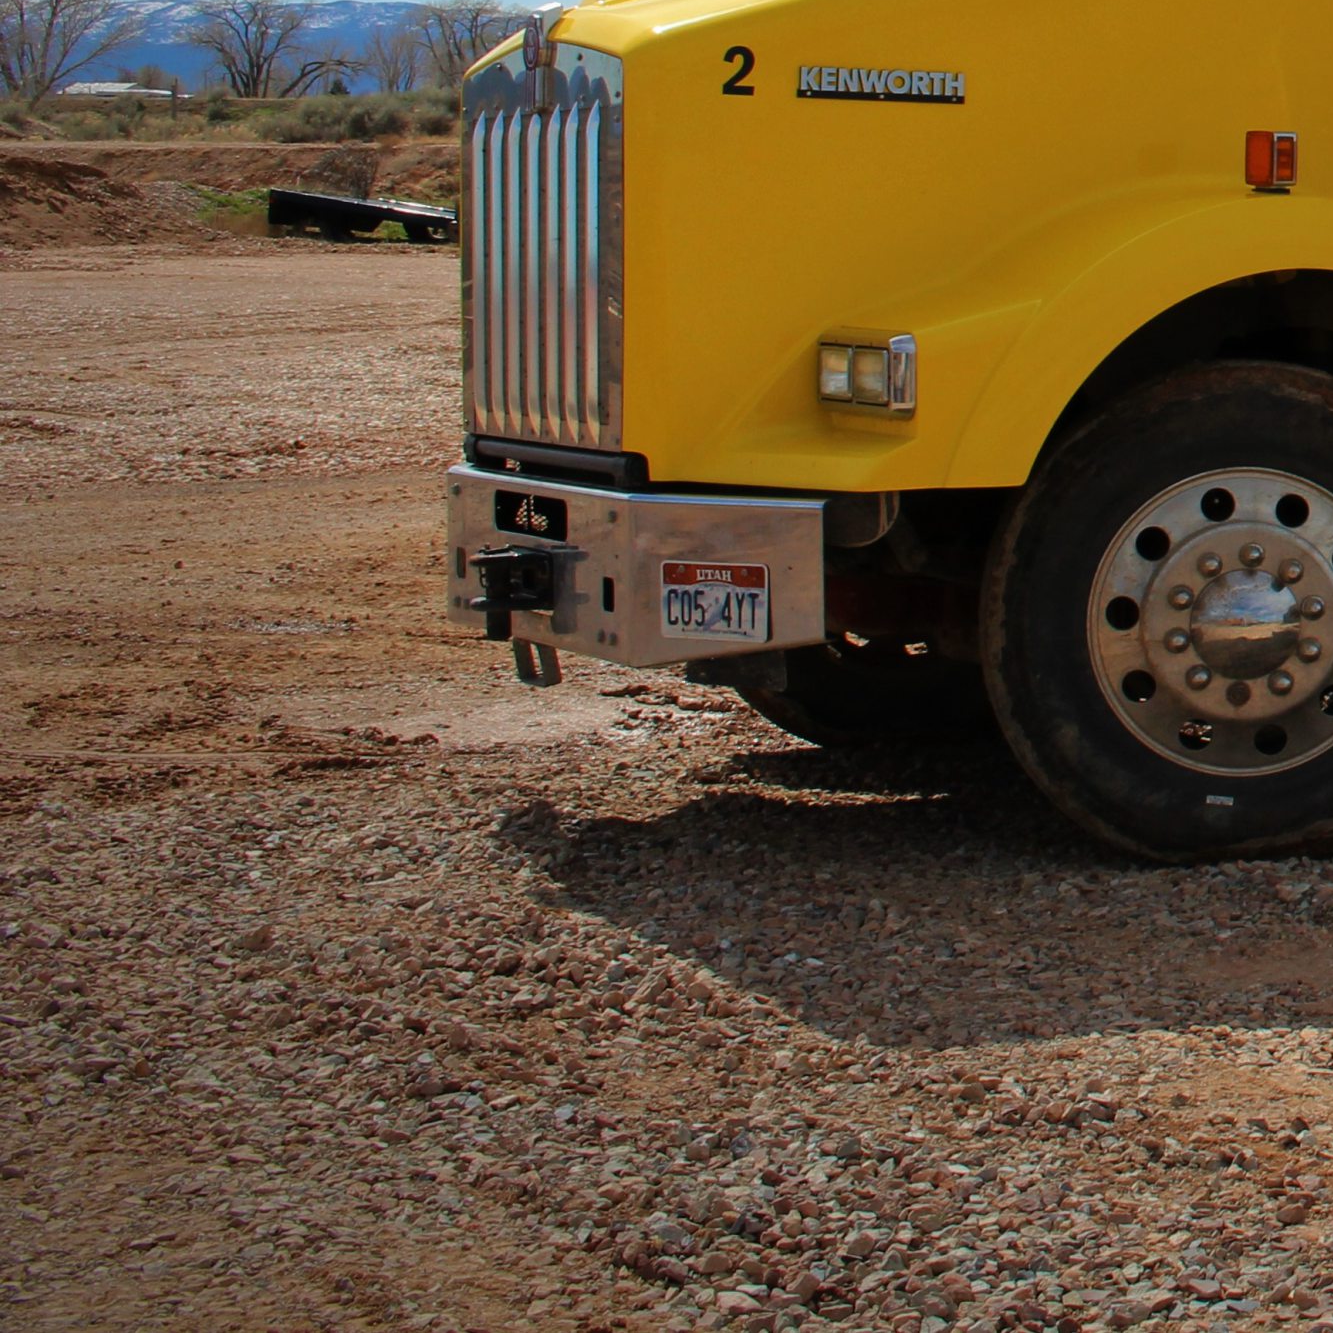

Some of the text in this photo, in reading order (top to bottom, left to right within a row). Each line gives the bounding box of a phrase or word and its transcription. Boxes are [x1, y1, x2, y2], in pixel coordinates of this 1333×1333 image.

[722, 45, 755, 96] 2
[800, 66, 965, 97] KENWORTH
[696, 569, 732, 582] UTAH
[721, 591, 759, 630] 4YT
